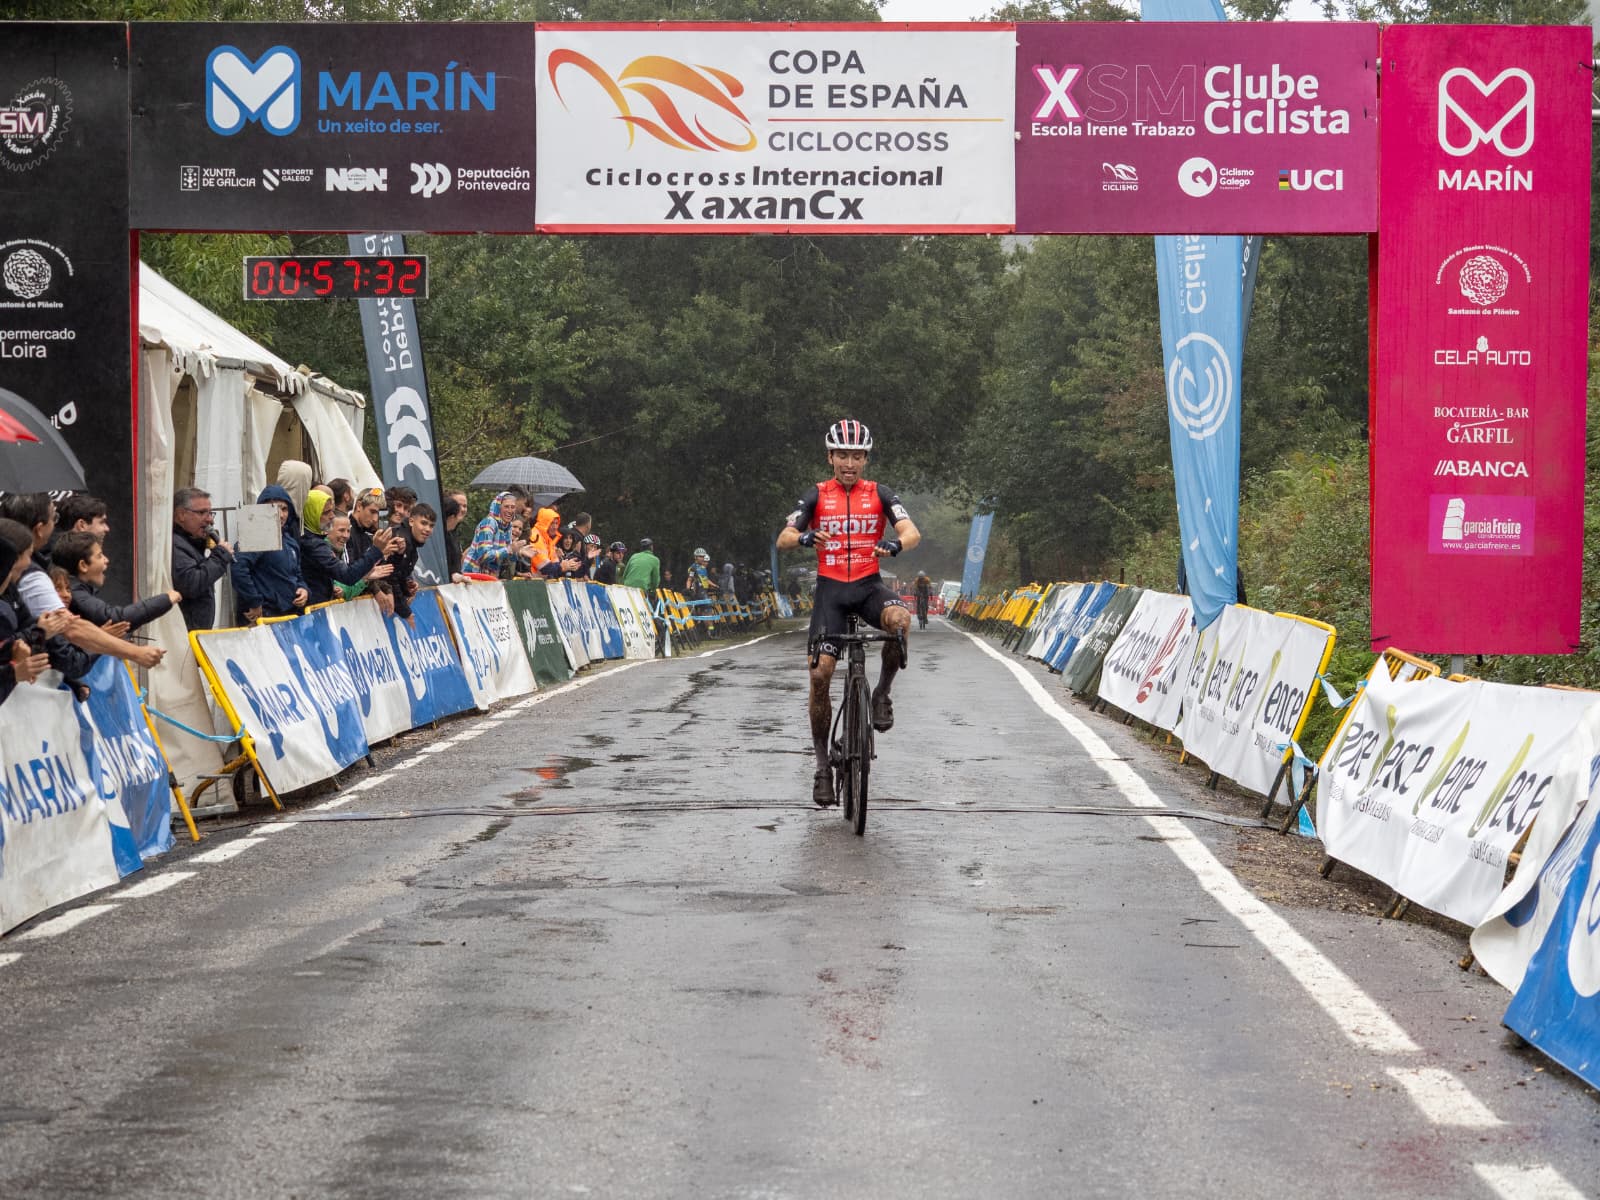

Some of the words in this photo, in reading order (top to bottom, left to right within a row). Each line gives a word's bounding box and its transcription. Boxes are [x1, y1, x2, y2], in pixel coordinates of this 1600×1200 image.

[769, 49, 865, 74] COPA
[318, 61, 497, 111] MARÍN
[1205, 64, 1319, 99] Clube
[769, 84, 814, 109] DE
[828, 78, 968, 109] ESPAÑA
[1032, 63, 1197, 122] XSM
[0, 112, 45, 134] SM
[1204, 98, 1349, 134] Ciclista
[318, 119, 341, 133] Un
[345, 119, 386, 133] xeito
[390, 119, 413, 133] de
[415, 122, 443, 133] ser.
[1032, 122, 1081, 137] Escola
[1087, 122, 1127, 137] Irene
[1132, 122, 1195, 137] Trabazo
[768, 131, 949, 152] CICLOCROSS
[203, 168, 235, 177] XUNTA
[457, 167, 530, 180] Deputación
[586, 167, 746, 186] Ciclocross
[752, 165, 943, 186] Internacional
[1220, 168, 1255, 177] Ciclismo
[1290, 169, 1343, 191] UCI
[1438, 165, 1532, 192] MARÍN
[203, 178, 215, 187] DE
[217, 178, 256, 187] GALICIA
[457, 180, 530, 191] Pontevedra
[1220, 178, 1251, 187] Galego
[252, 260, 421, 295] 00:57:32
[0, 328, 76, 342] permercado
[1, 342, 47, 358] Loira
[1434, 350, 1478, 365] CELA
[1486, 351, 1531, 366] AUTO
[1434, 404, 1498, 418] BOCATERÍA
[1506, 407, 1529, 418] BAR
[1446, 425, 1513, 444] GARFIL
[1442, 541, 1520, 550] www.garciafreire.es
[1263, 680, 1304, 734] ence
